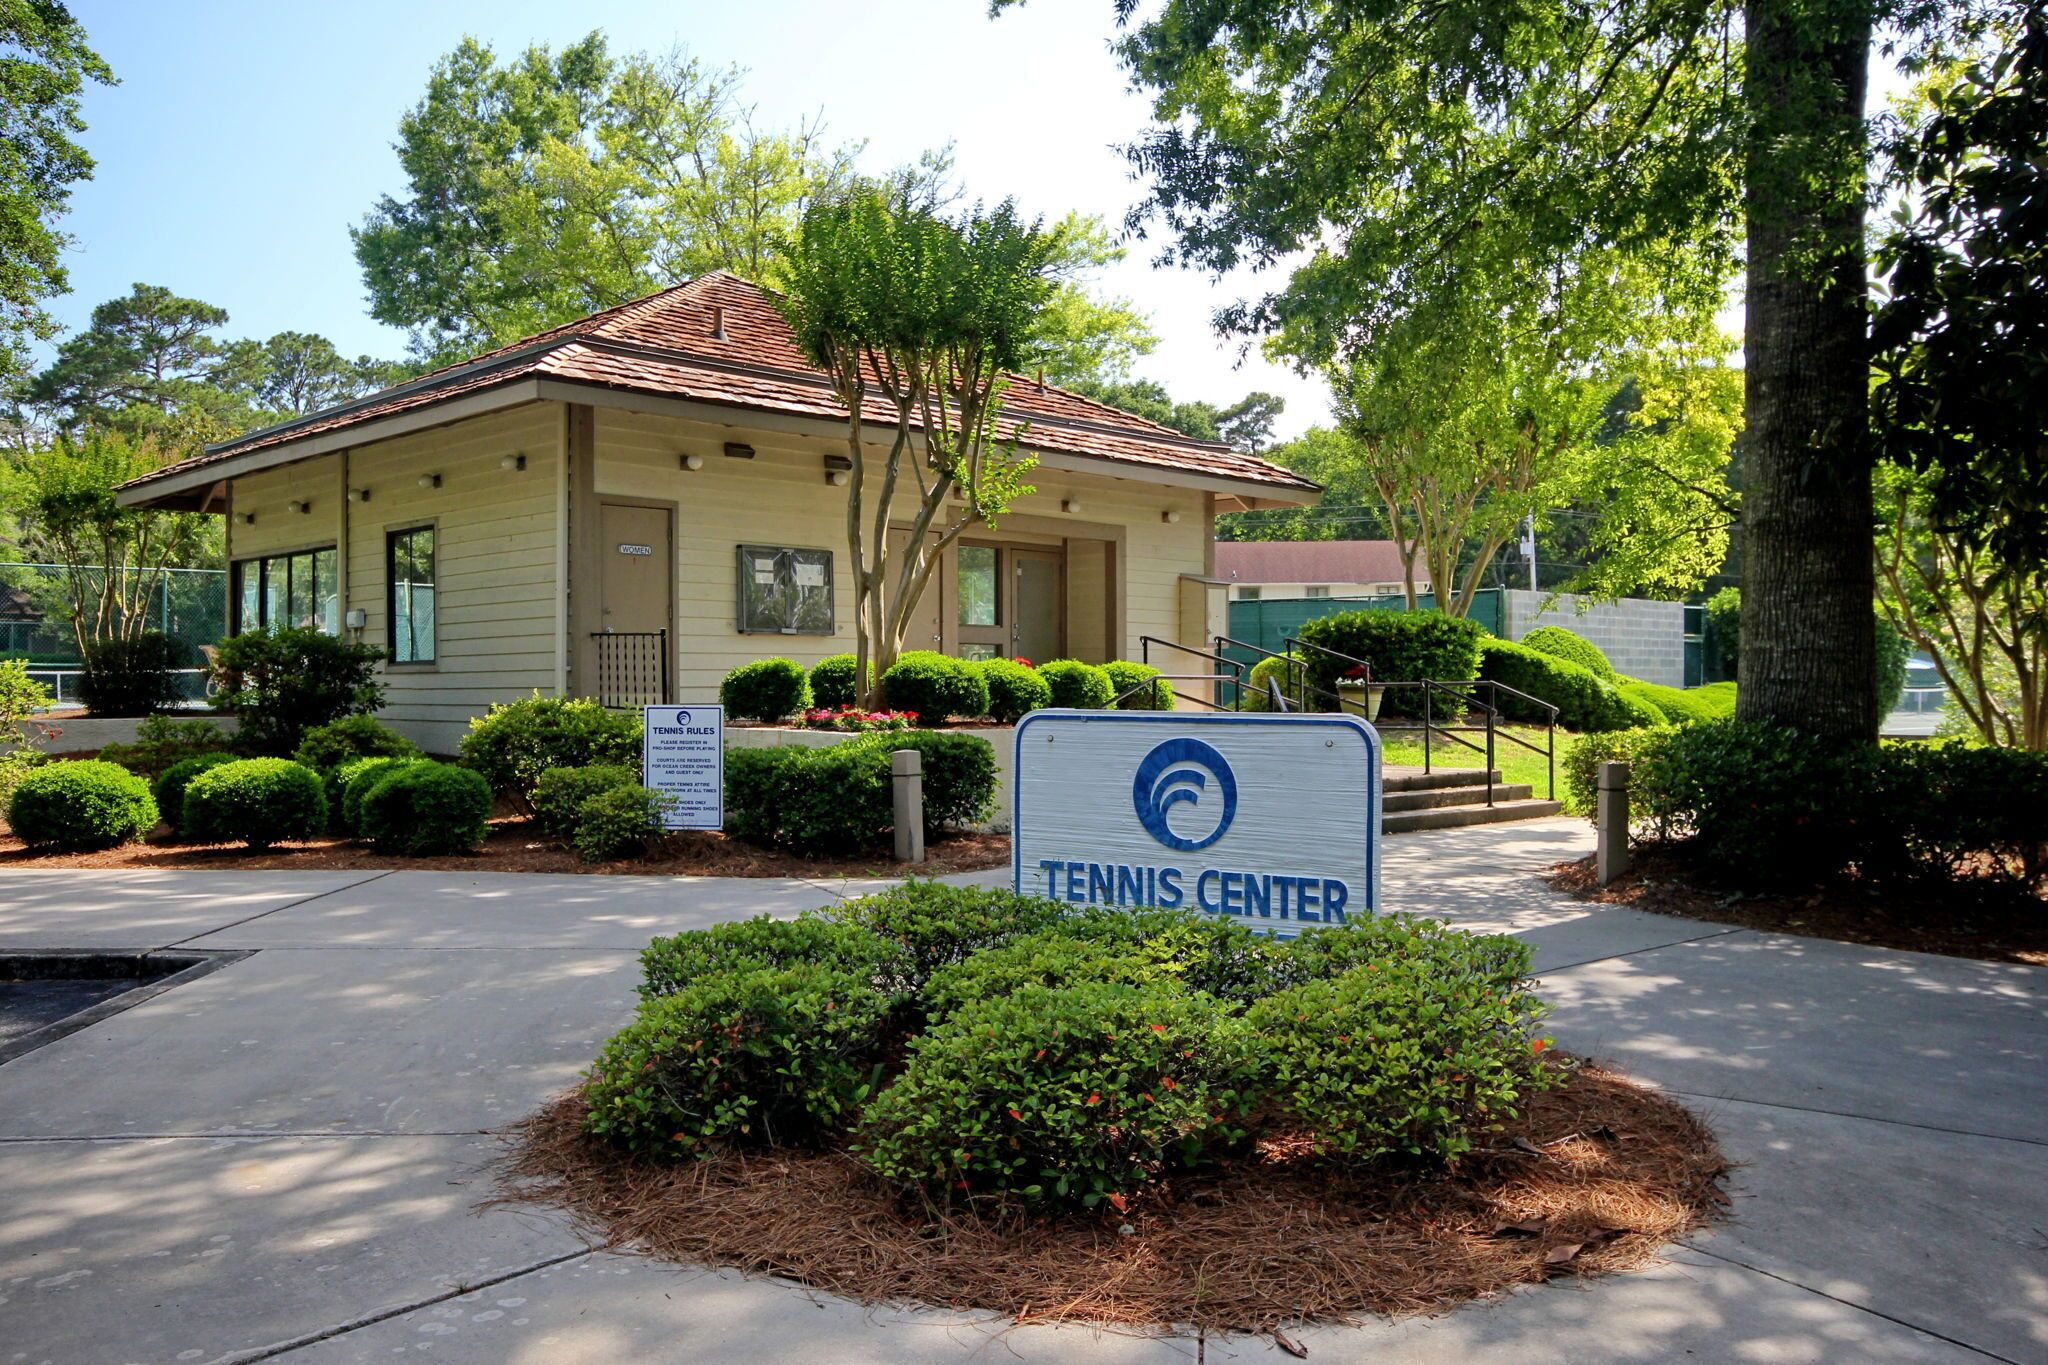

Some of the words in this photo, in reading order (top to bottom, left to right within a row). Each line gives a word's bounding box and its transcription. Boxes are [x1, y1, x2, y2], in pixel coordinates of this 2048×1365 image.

[622, 546, 650, 554] WOMEN
[1039, 859, 1184, 909] TENNIS
[1196, 869, 1349, 924] CENTER
